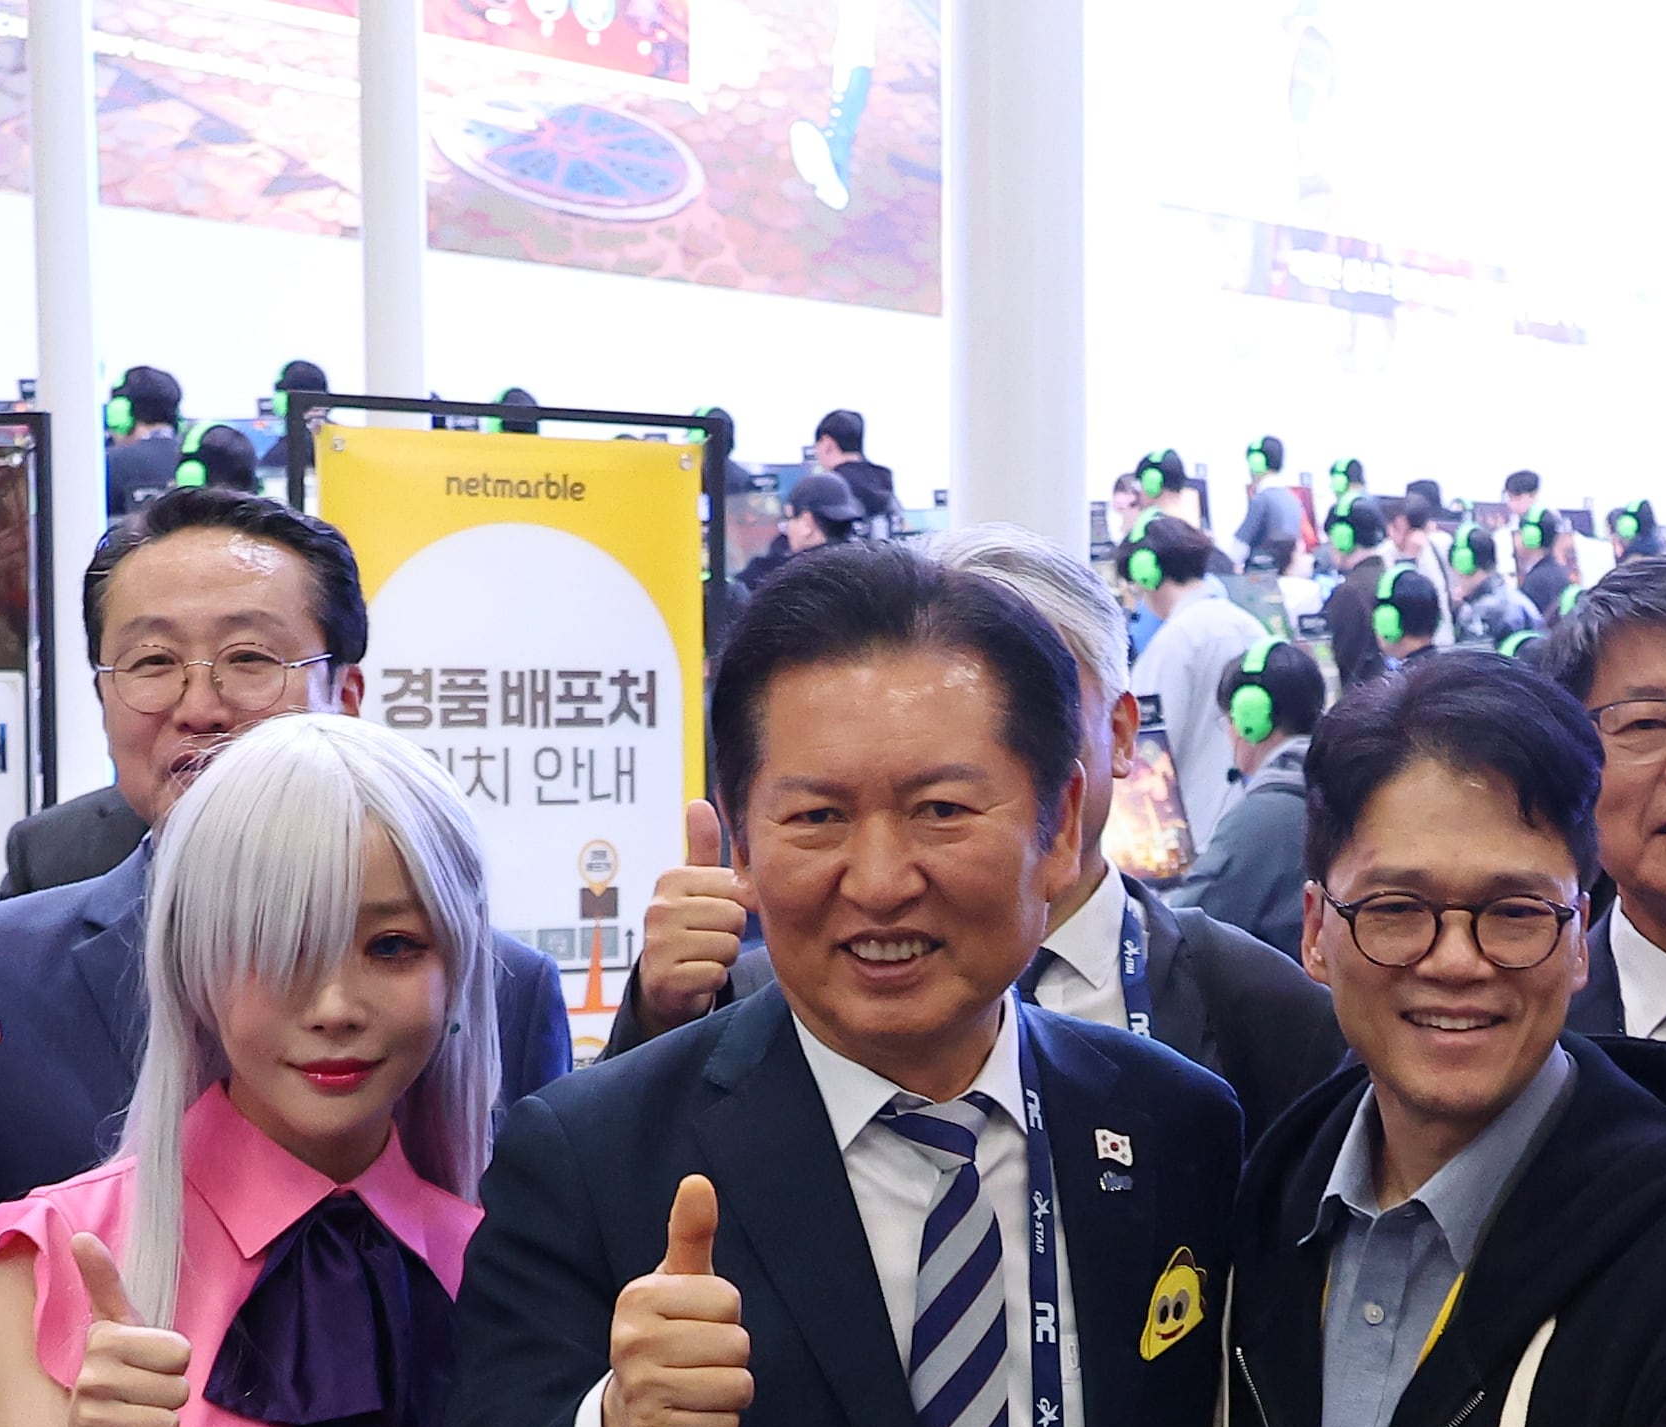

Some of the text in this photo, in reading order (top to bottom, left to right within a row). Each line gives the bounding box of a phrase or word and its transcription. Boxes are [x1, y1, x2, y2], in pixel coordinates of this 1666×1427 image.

[446, 473, 586, 502] netmarble
[381, 668, 657, 730] 경품 배포처
[533, 746, 637, 806] 안내
